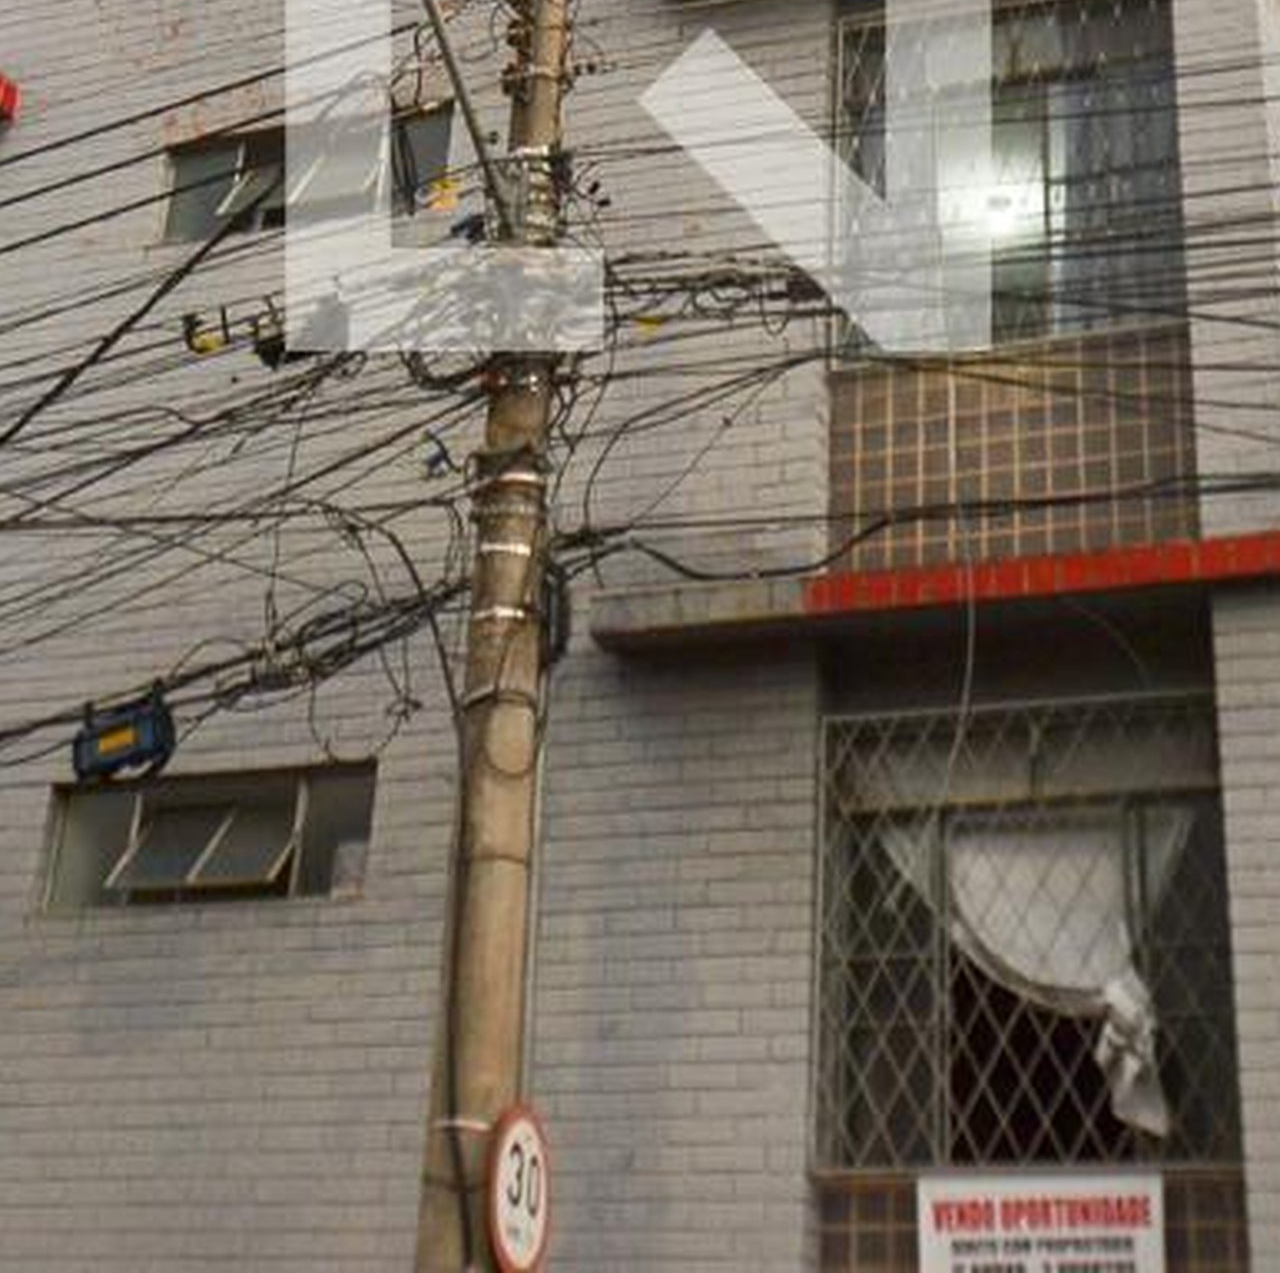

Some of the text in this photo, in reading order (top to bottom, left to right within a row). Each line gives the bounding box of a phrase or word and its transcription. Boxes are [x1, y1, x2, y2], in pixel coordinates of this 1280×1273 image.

[506, 1141, 541, 1218] 30
[932, 1194, 1151, 1231] VENDO OPORTUNIDADE
